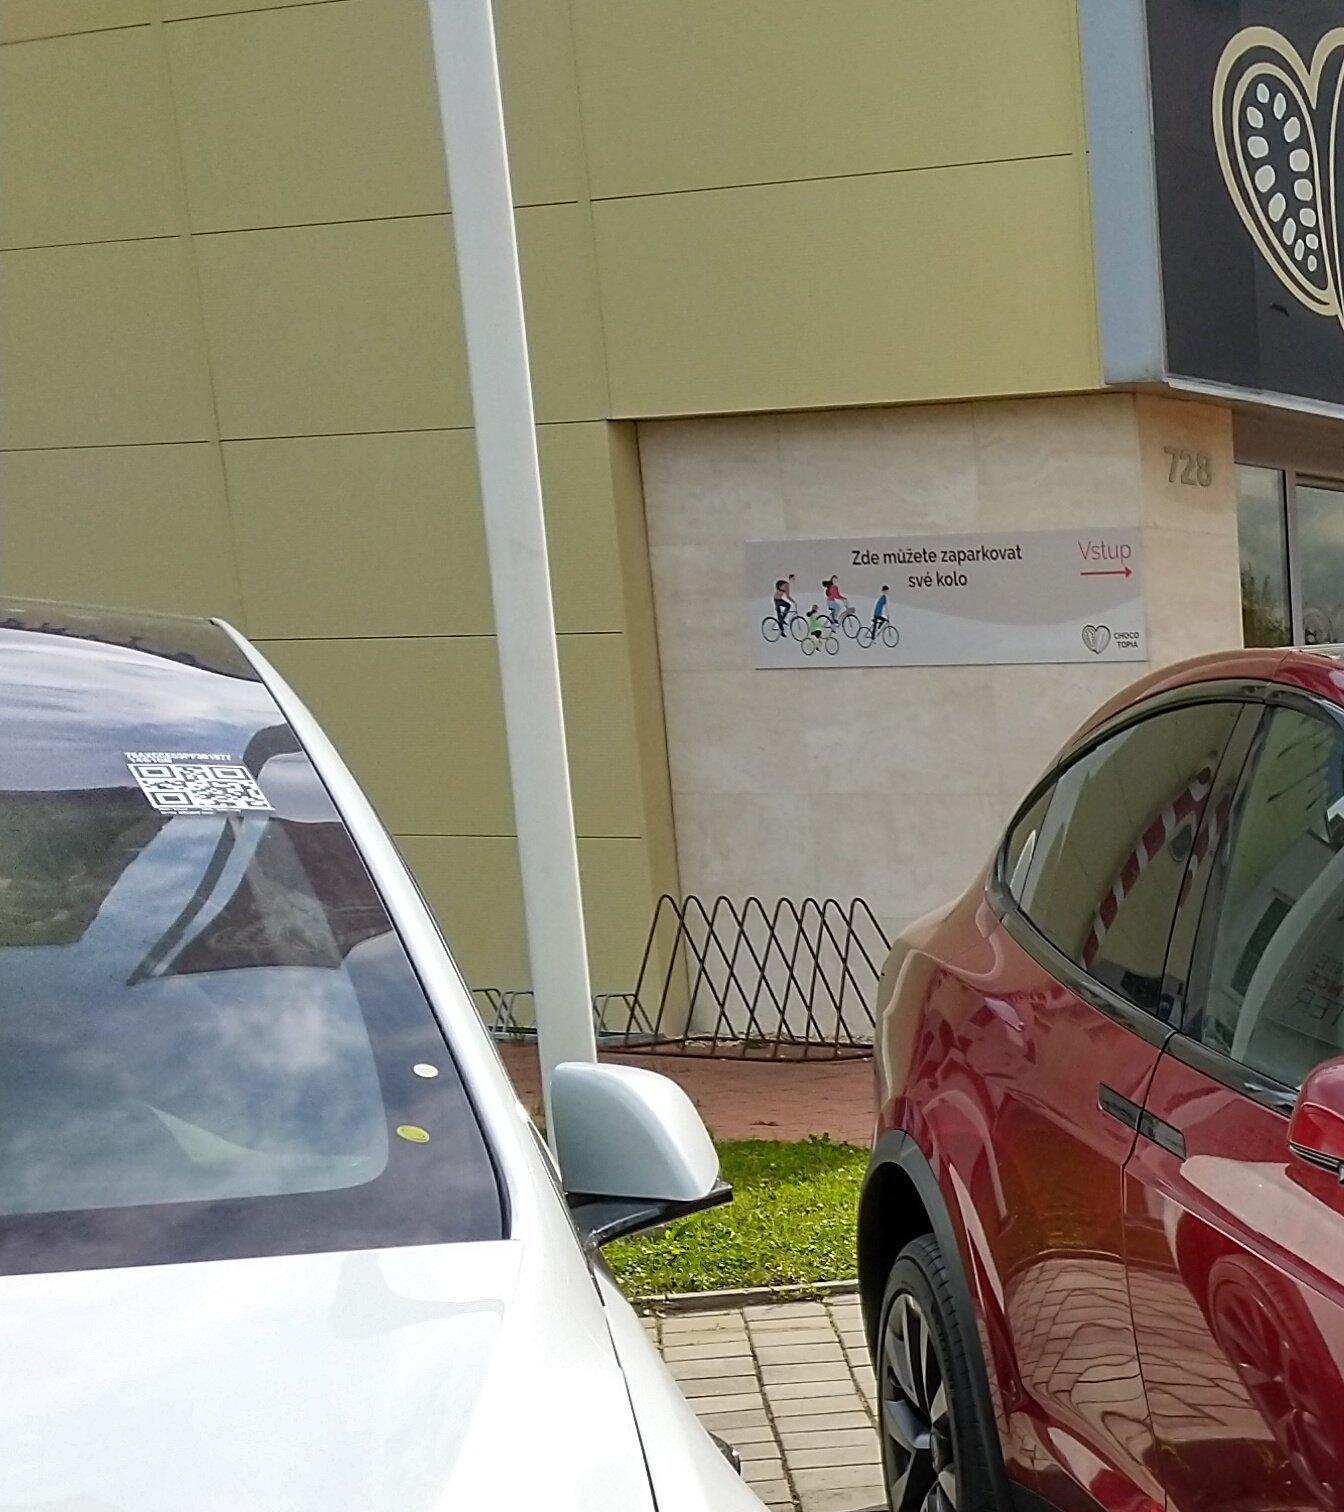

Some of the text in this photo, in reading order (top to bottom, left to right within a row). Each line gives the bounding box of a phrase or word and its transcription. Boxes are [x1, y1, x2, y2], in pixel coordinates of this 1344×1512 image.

[1162, 446, 1211, 487] 728
[851, 544, 1023, 566] Zde můžete zaparkovat
[1078, 540, 1132, 564] Vstup
[908, 570, 968, 588] své kolo
[1113, 632, 1140, 640] CHOCO
[1116, 640, 1139, 649] TOPIA
